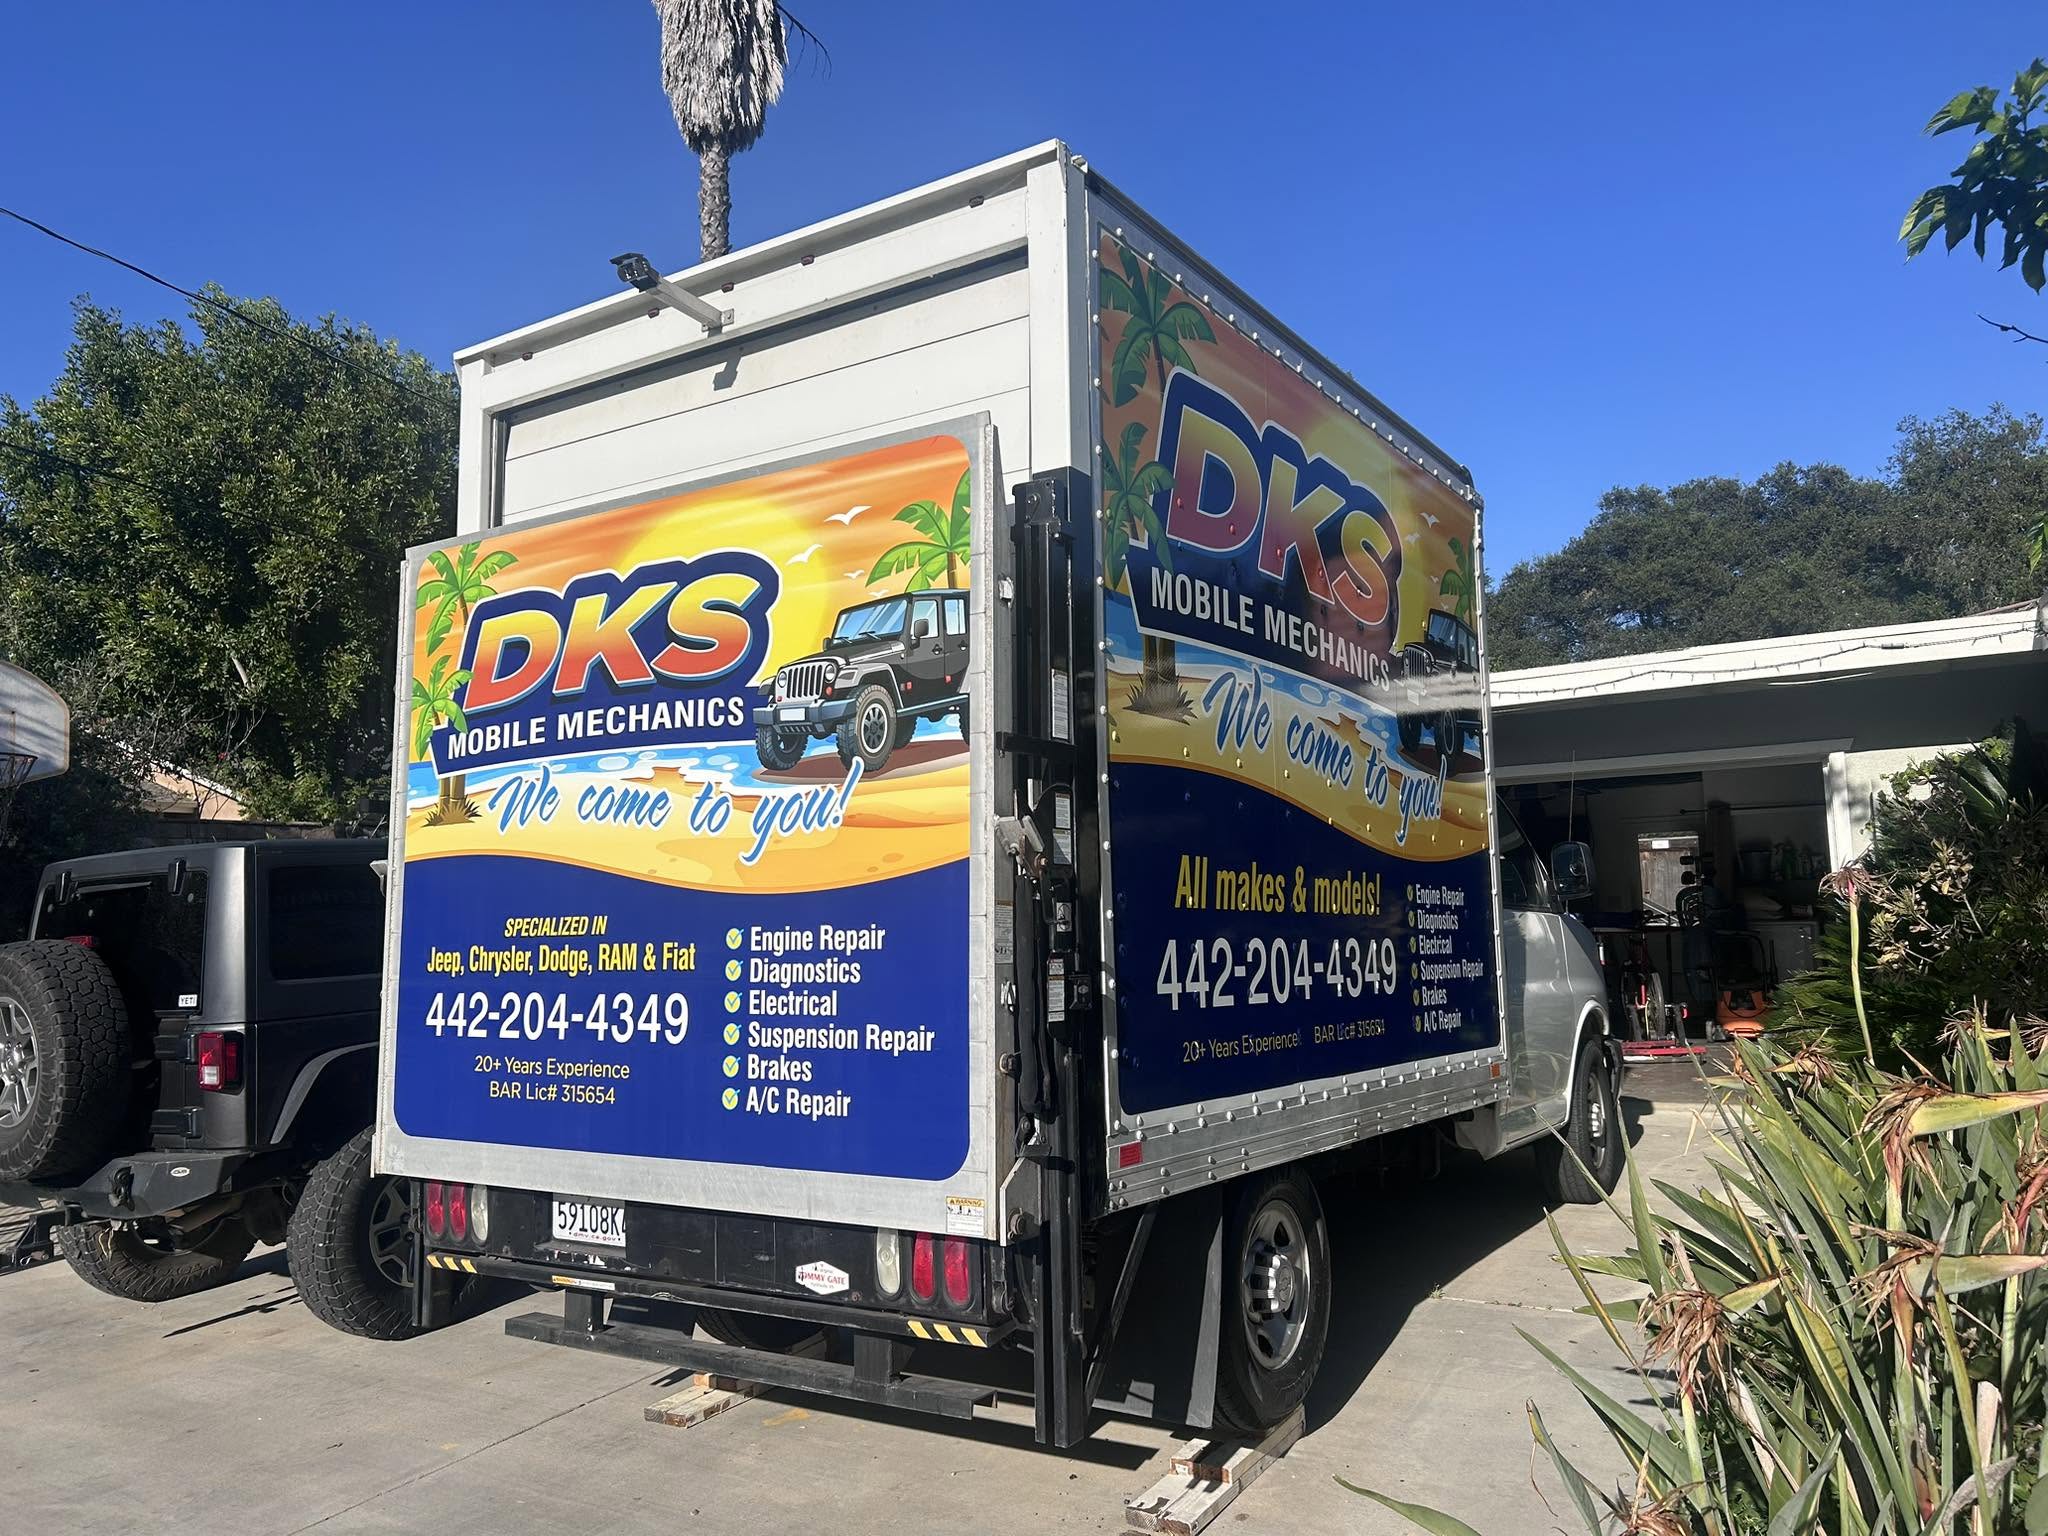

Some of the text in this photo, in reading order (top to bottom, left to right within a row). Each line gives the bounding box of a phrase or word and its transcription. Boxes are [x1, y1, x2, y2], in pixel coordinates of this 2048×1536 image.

[1166, 404, 1393, 626] DKS
[462, 572, 764, 714] DKS
[1150, 566, 1391, 693] MOBILE MECHANICS
[448, 696, 745, 760] MOBILE MECHANICS
[1203, 665, 1447, 845] We come to you!
[489, 757, 864, 865] We come to you!
[1174, 855, 1381, 917] All makes & models!
[1416, 883, 1464, 910] Engine Repair
[504, 916, 608, 937] SPECIALIZED IN
[1417, 909, 1459, 934] Diagnostics
[751, 924, 885, 956] Engine Repair
[1419, 934, 1453, 955] Electrical
[427, 942, 696, 977] Jeep, Chrysler, Dodge, RAM & Fiat
[750, 957, 861, 988] Diagnostics
[1157, 937, 1398, 1011] 442-204-4349
[1420, 958, 1484, 984] Suspension Repair
[180, 996, 196, 1005] YETI
[749, 989, 837, 1016] Electrical
[1422, 985, 1447, 1006] Brakes
[426, 991, 689, 1045] 442-204-4349
[1424, 1008, 1462, 1034] A/C Repair
[748, 1021, 935, 1056] Suspension Repair
[1183, 1031, 1298, 1062] 20+ Years Experience
[1314, 1025, 1336, 1044] BAR
[474, 1055, 630, 1079] 20+ Years Experience
[748, 1053, 812, 1082] Brakes
[489, 1081, 616, 1105] BAR Lic# 315654
[746, 1086, 851, 1121] A/C Repair
